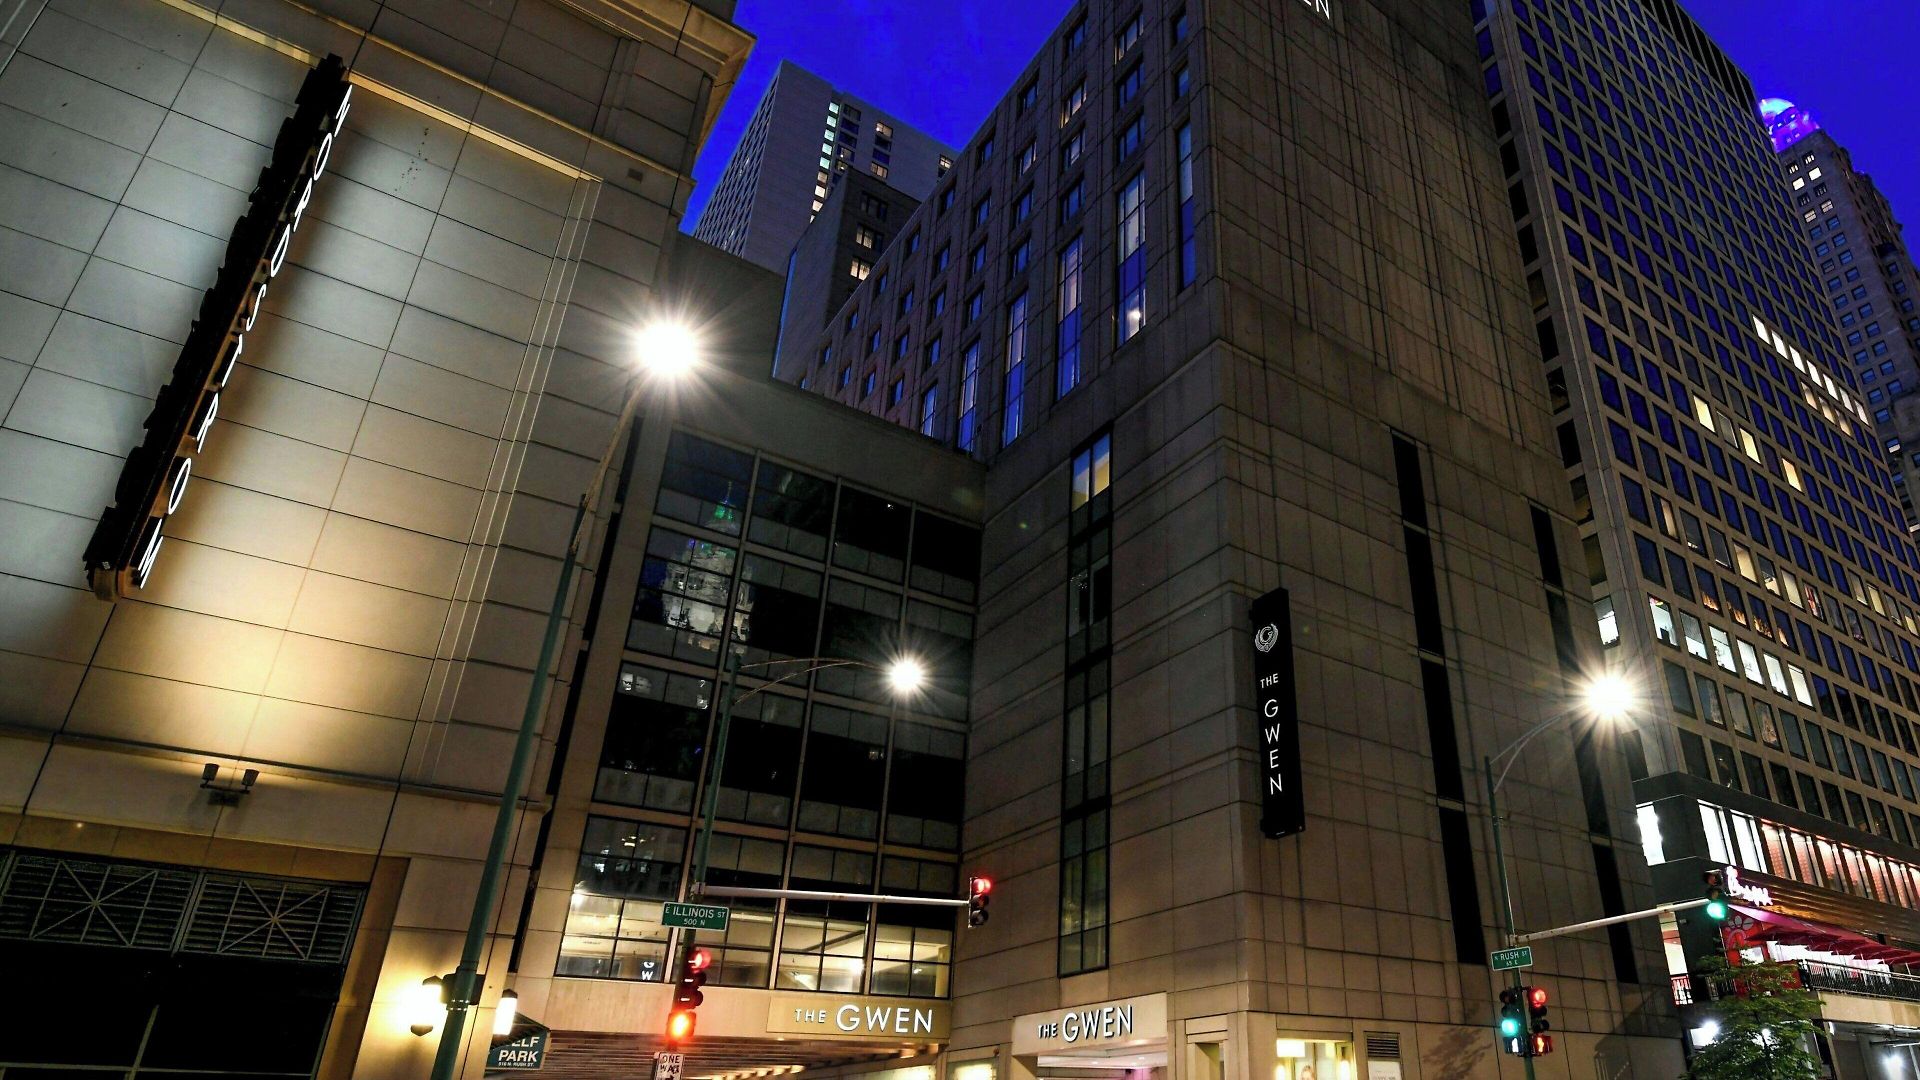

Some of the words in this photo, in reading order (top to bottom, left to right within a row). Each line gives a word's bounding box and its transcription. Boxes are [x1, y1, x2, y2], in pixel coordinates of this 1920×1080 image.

[1259, 673, 1279, 689] THE
[1264, 699, 1283, 796] GWEN
[665, 906, 670, 914] E
[672, 906, 715, 919] ILLINOIS
[683, 918, 697, 926] 500
[1500, 951, 1520, 961] RUSH
[794, 1008, 827, 1024] THE
[835, 1004, 933, 1034] GWEN
[1037, 1022, 1059, 1040] THE
[1062, 1004, 1134, 1043] GWEN
[498, 1049, 539, 1063] PARK
[662, 1055, 681, 1064] ONE
